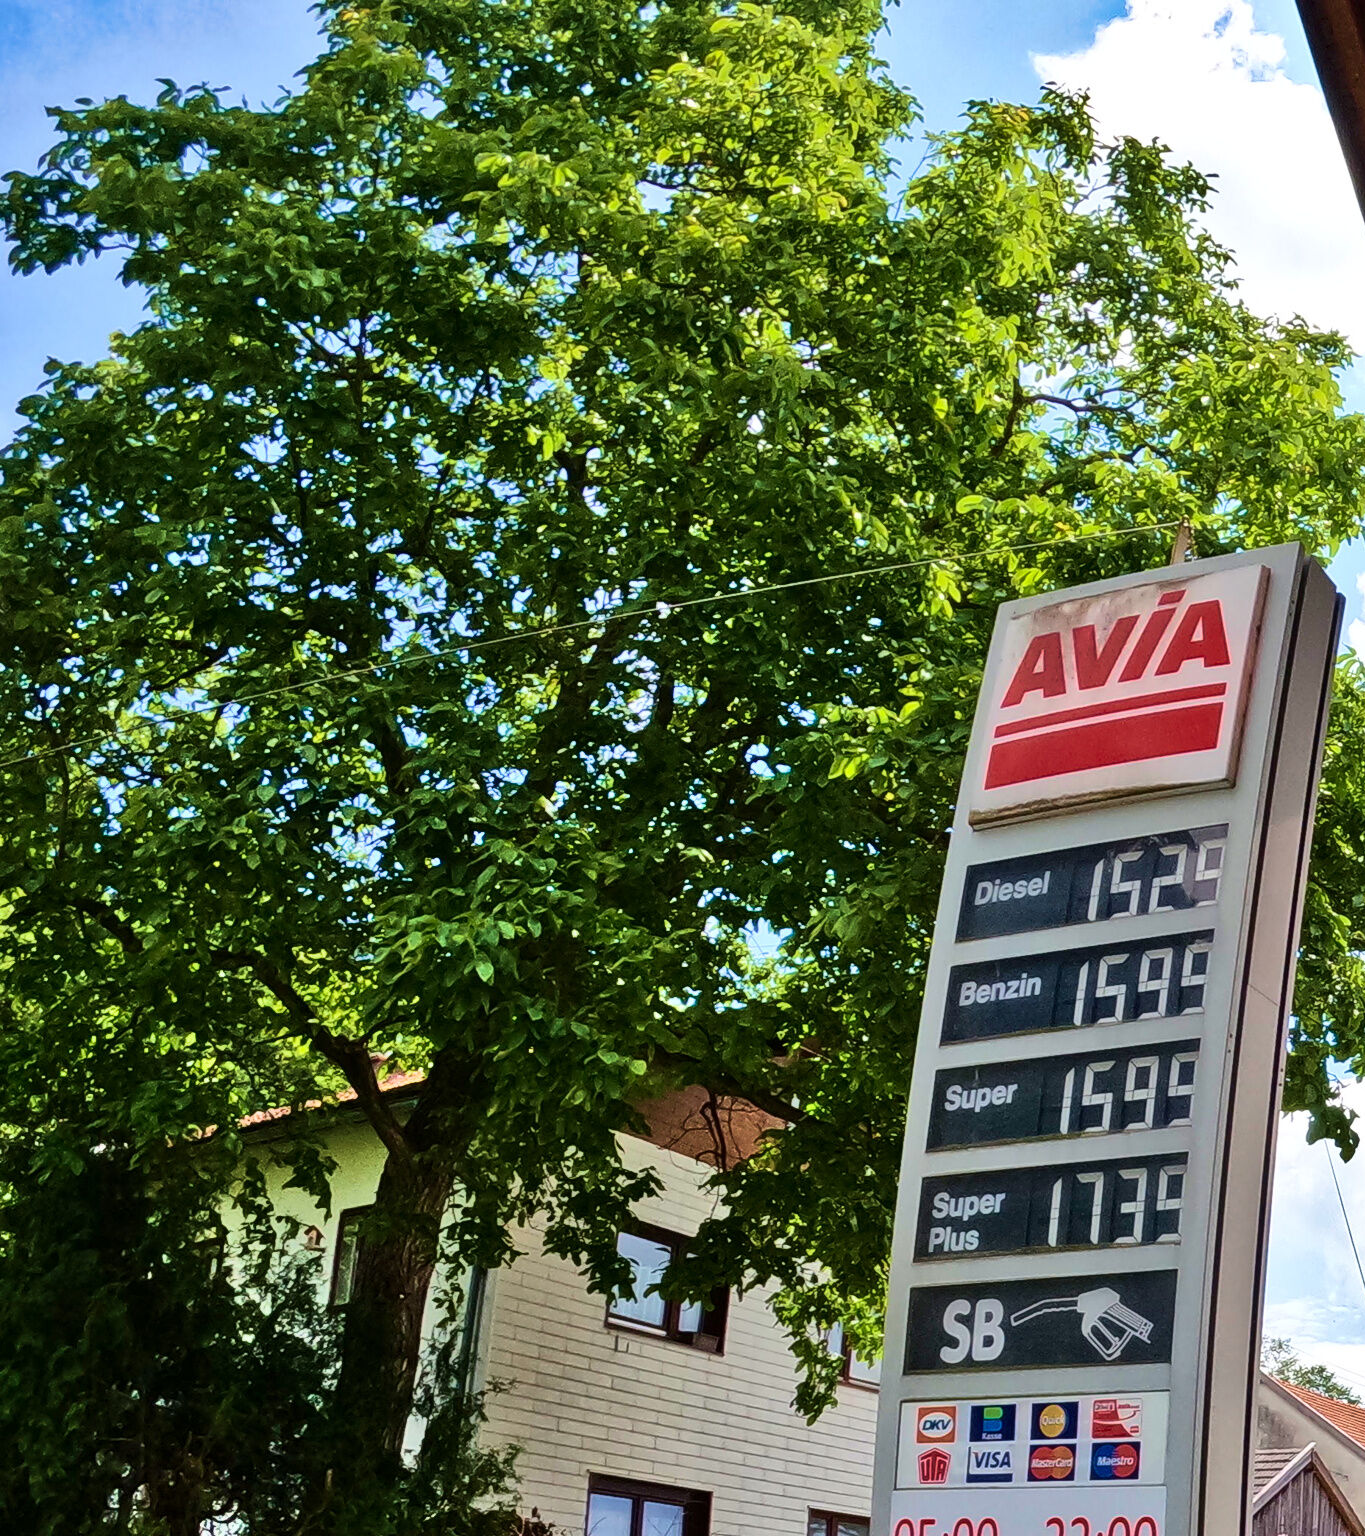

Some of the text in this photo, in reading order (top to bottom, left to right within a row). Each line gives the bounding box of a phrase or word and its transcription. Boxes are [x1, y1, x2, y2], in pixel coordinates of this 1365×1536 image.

[1000, 589, 1231, 709] AVIA
[974, 871, 1050, 907] Diesel
[958, 974, 1042, 1007] Benzin
[944, 1083, 1018, 1112] Super
[931, 1191, 1006, 1222] Super
[928, 1226, 979, 1252] Plus
[939, 1298, 1005, 1364] SB
[922, 1418, 951, 1431] DKV
[1041, 1414, 1064, 1426] Quick
[972, 1451, 1011, 1469] VISA
[1031, 1457, 1073, 1468] MasterCard
[1096, 1456, 1134, 1466] Maestro
